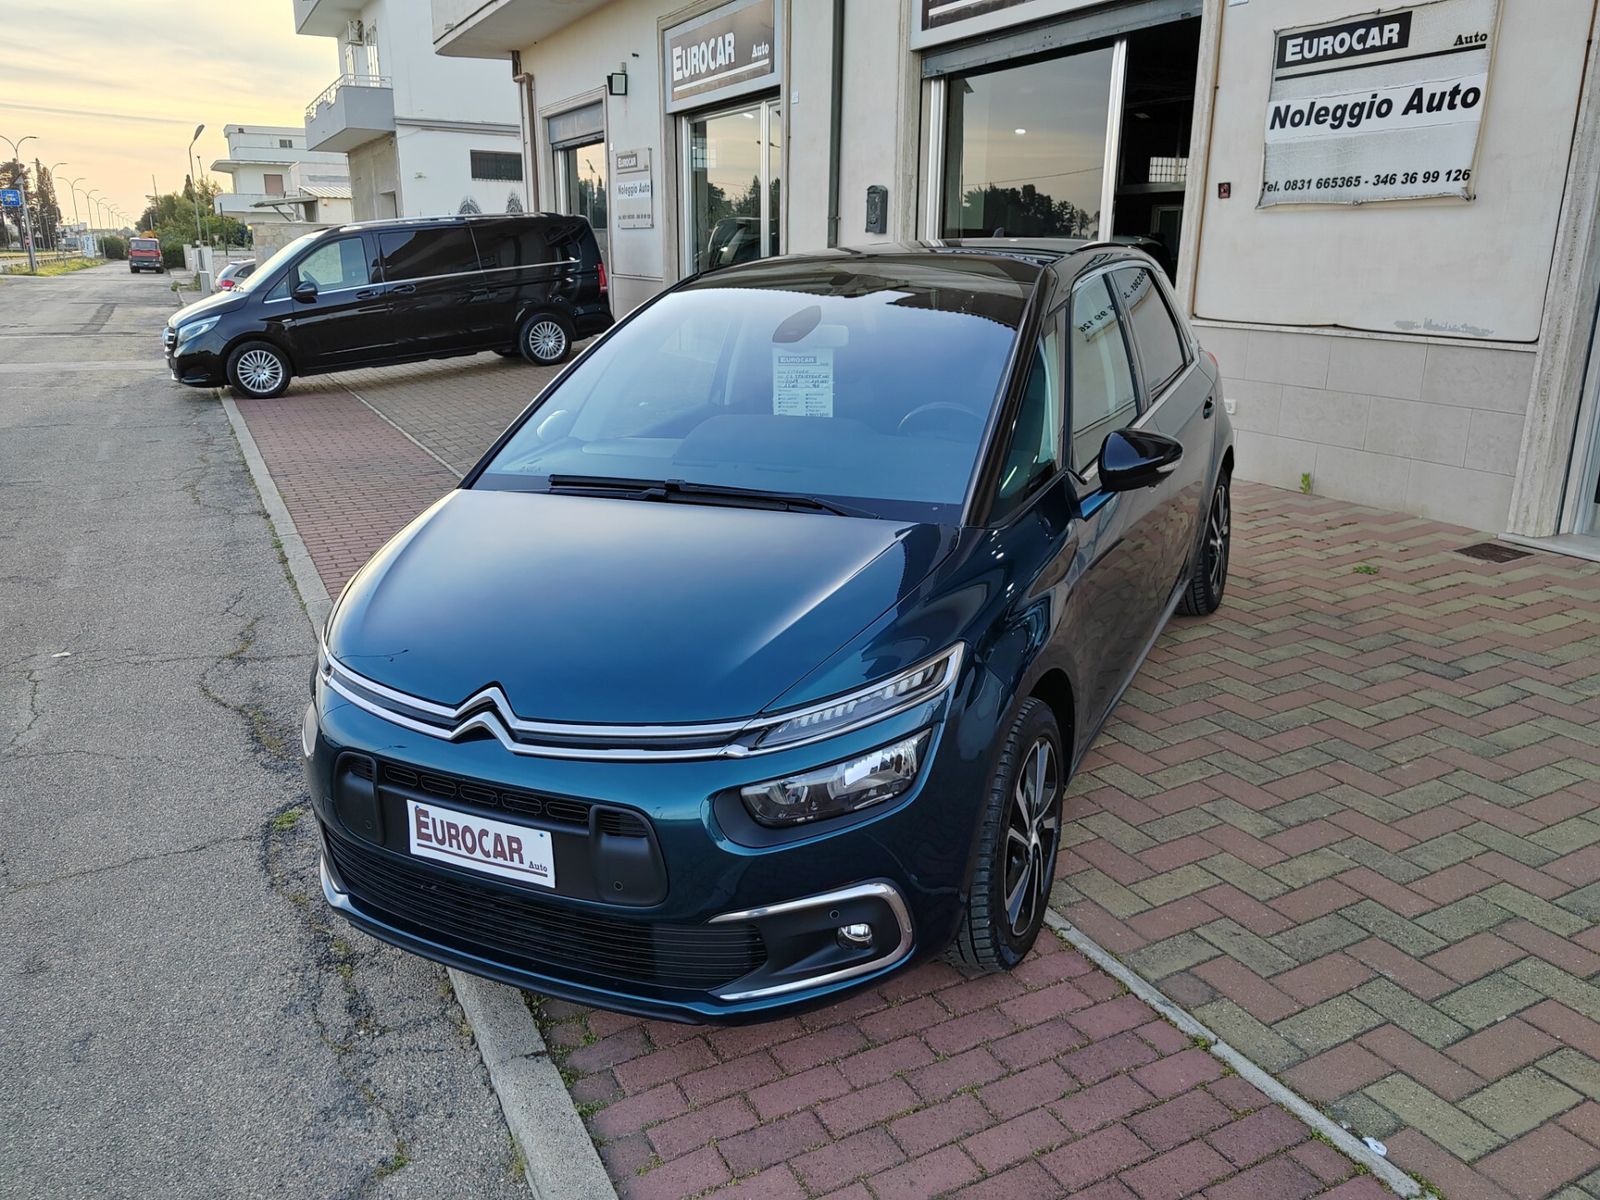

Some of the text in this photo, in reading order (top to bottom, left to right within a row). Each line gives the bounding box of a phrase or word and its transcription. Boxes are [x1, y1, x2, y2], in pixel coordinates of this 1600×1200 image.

[751, 41, 770, 58] Auto
[1284, 22, 1400, 63] EUROCAR
[1453, 31, 1488, 47] Auto
[672, 32, 735, 81] EUROCAR
[1269, 83, 1481, 130] Noleggio Auto
[1262, 181, 1280, 192] Tel.
[1284, 178, 1312, 191] 0831
[1316, 176, 1362, 189] 665365
[1372, 173, 1397, 186] 346
[1400, 172, 1418, 184] 36
[1422, 170, 1440, 183] 99
[1445, 169, 1472, 182] 126
[415, 806, 524, 865] EUROCAR
[528, 861, 548, 872] Auto
